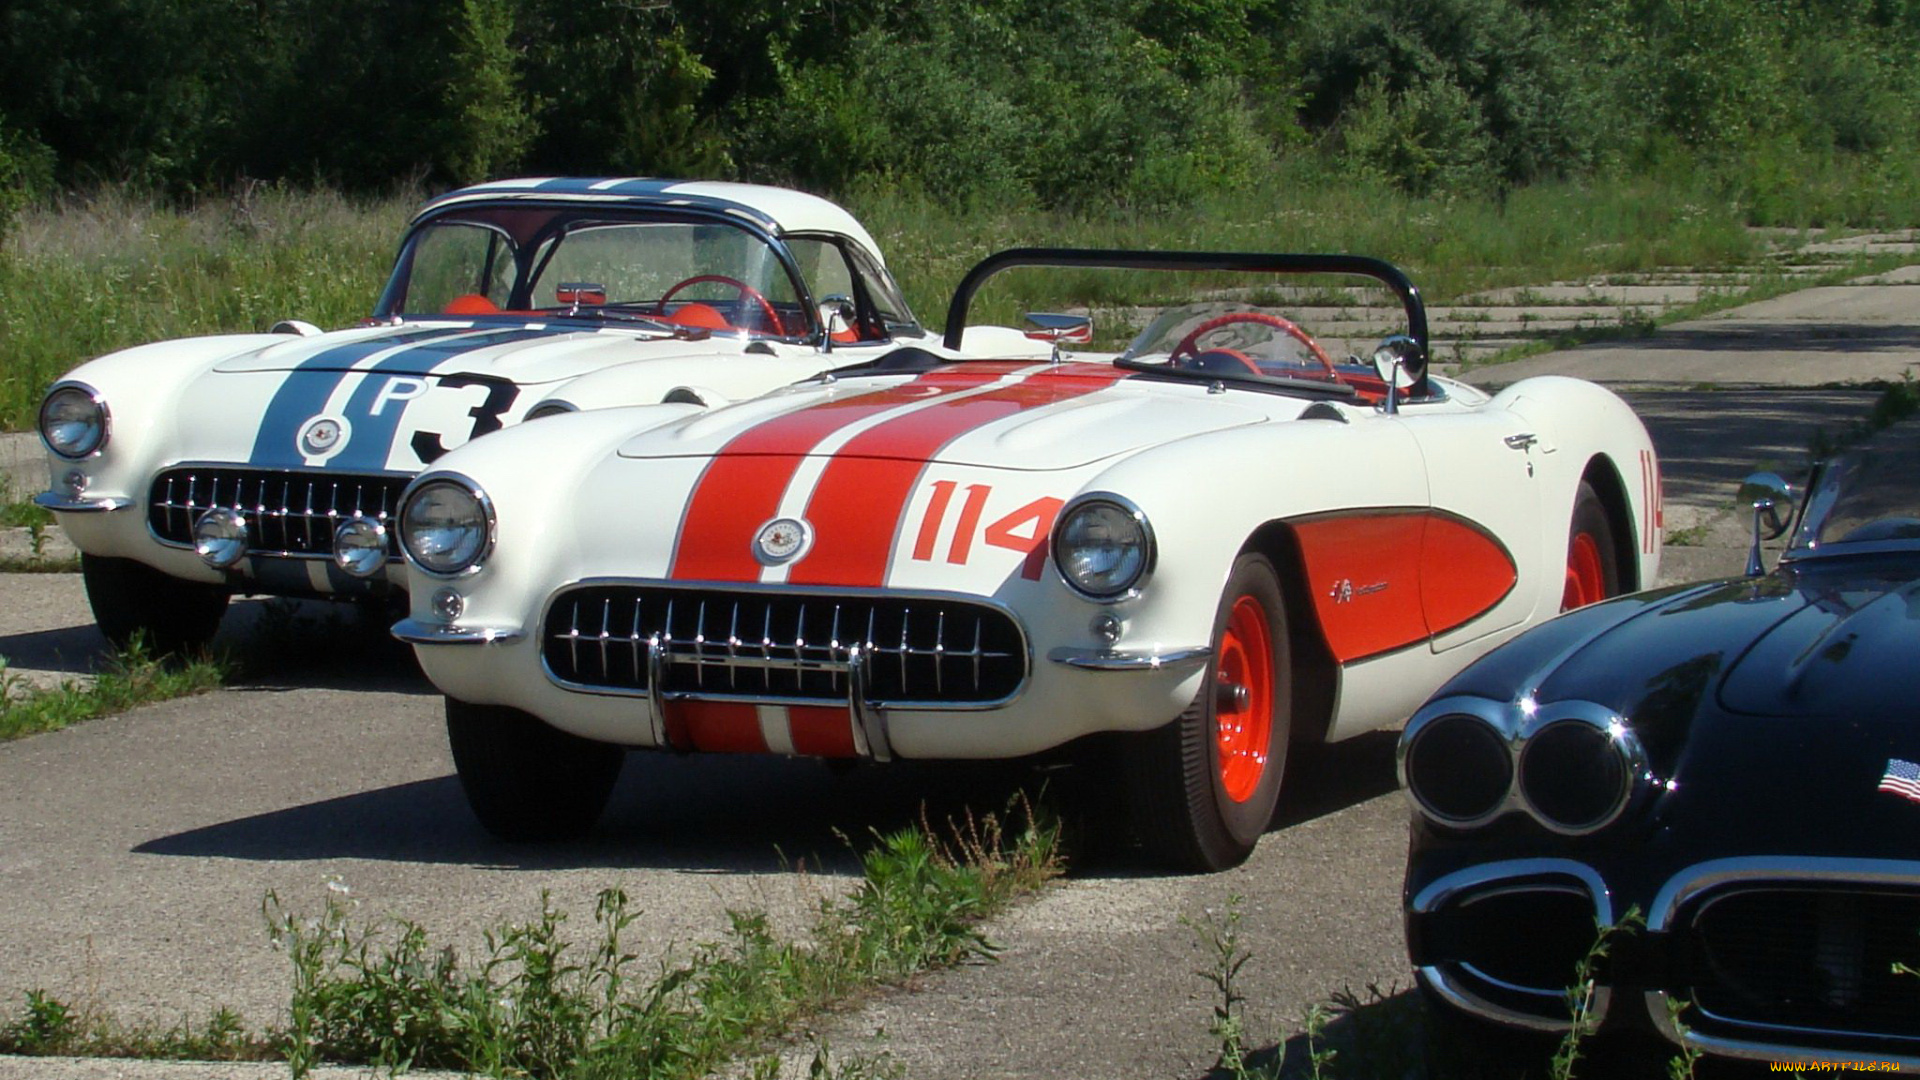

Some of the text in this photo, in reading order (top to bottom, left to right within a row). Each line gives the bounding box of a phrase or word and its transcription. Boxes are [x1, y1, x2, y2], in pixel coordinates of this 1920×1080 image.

[369, 377, 429, 416] P
[410, 371, 522, 465] 3
[912, 479, 1066, 582] 114
